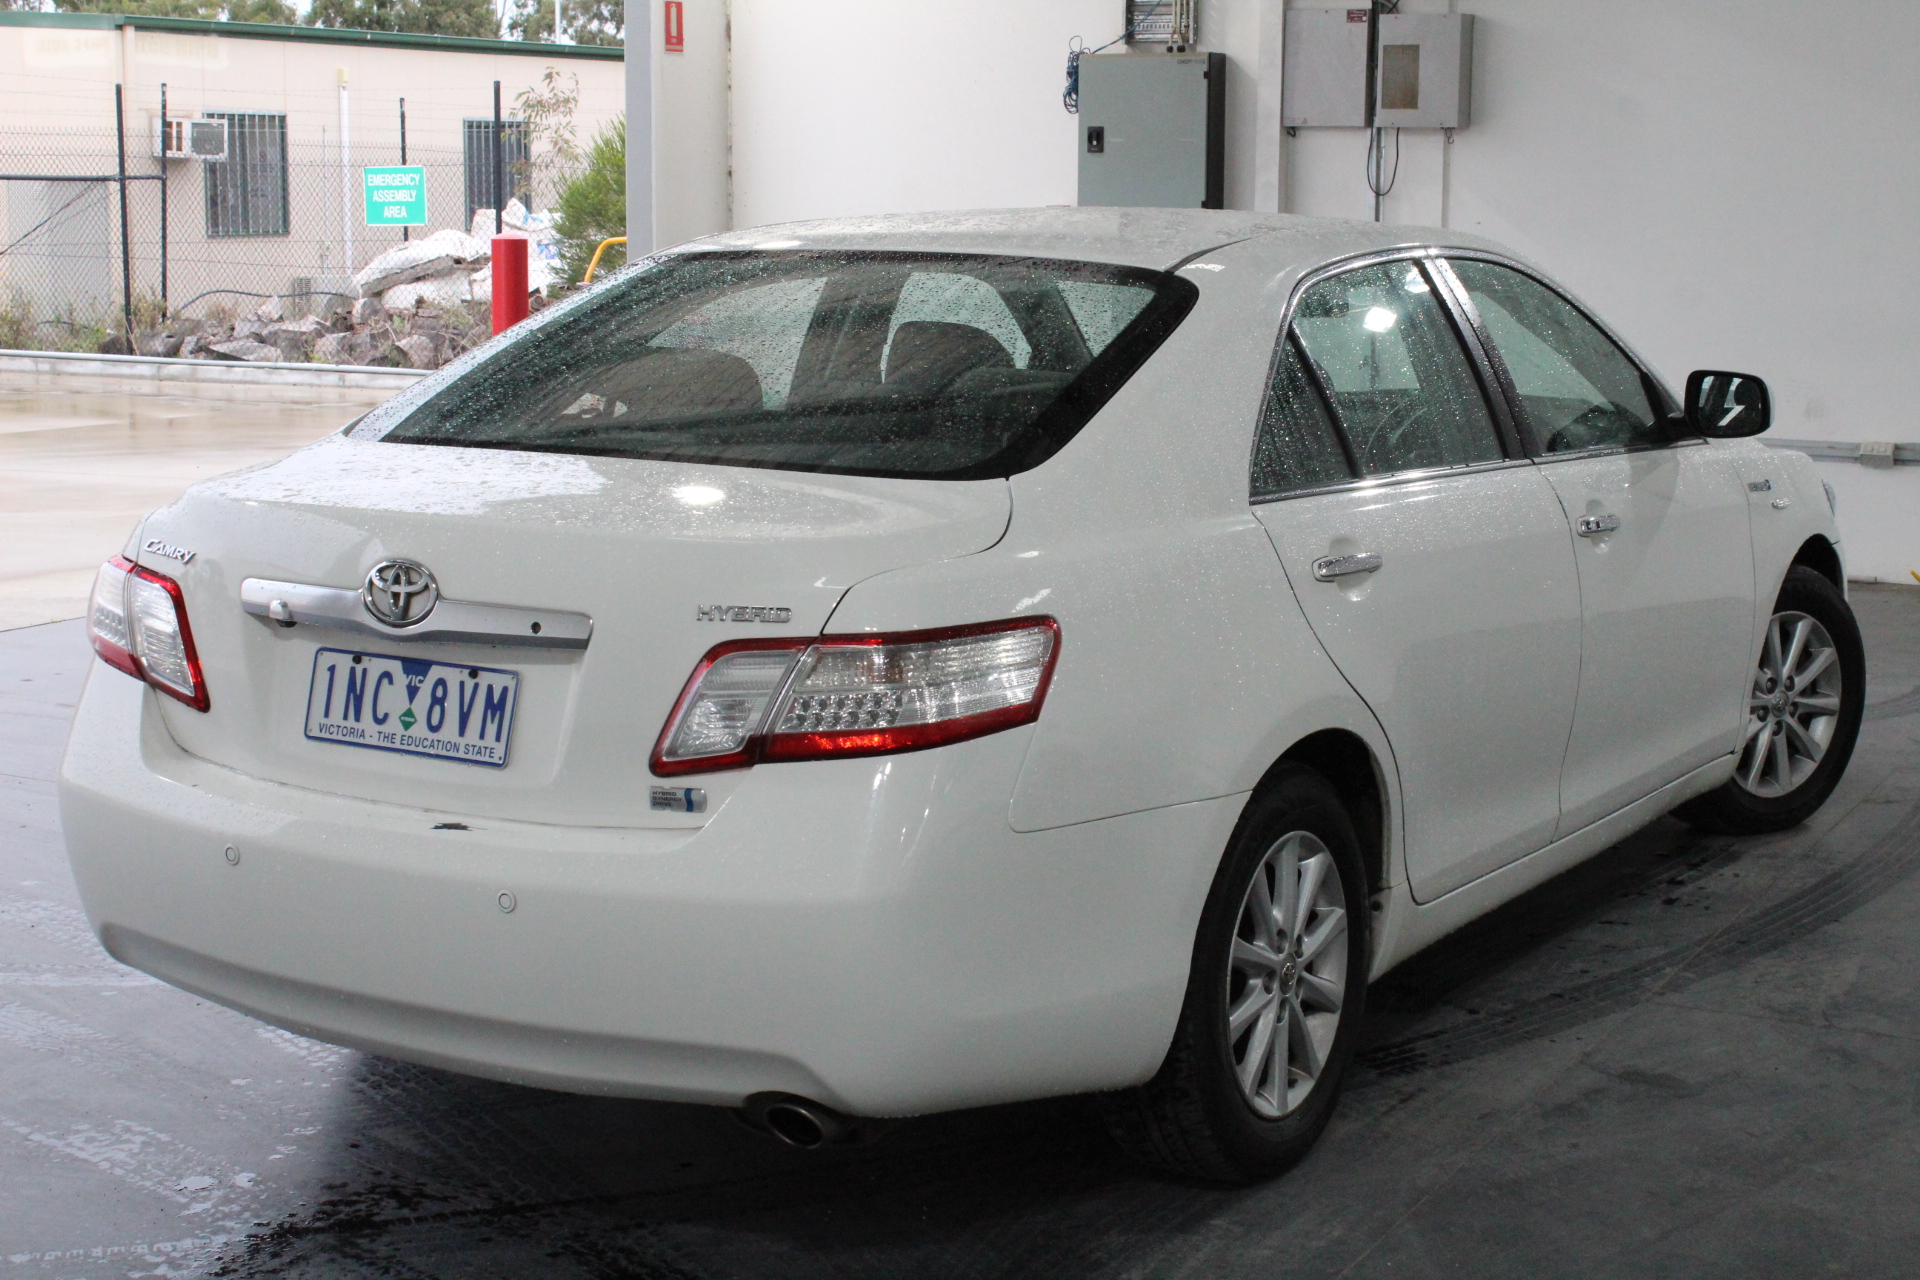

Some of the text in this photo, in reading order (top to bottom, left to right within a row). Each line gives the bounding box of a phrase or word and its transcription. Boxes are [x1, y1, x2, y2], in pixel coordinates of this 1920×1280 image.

[367, 173, 420, 187] EMERGENCY
[372, 189, 417, 202] ASSEMBLY
[383, 205, 408, 218] AREA
[143, 538, 196, 565] CAMRY
[696, 604, 792, 623] HYBRID
[406, 674, 425, 688] VIC
[323, 664, 509, 743] 1NC 8VM
[318, 722, 366, 740] VICTORIA
[377, 730, 397, 745] THE
[400, 734, 460, 754] EDUCATION
[464, 744, 496, 759] STATE
